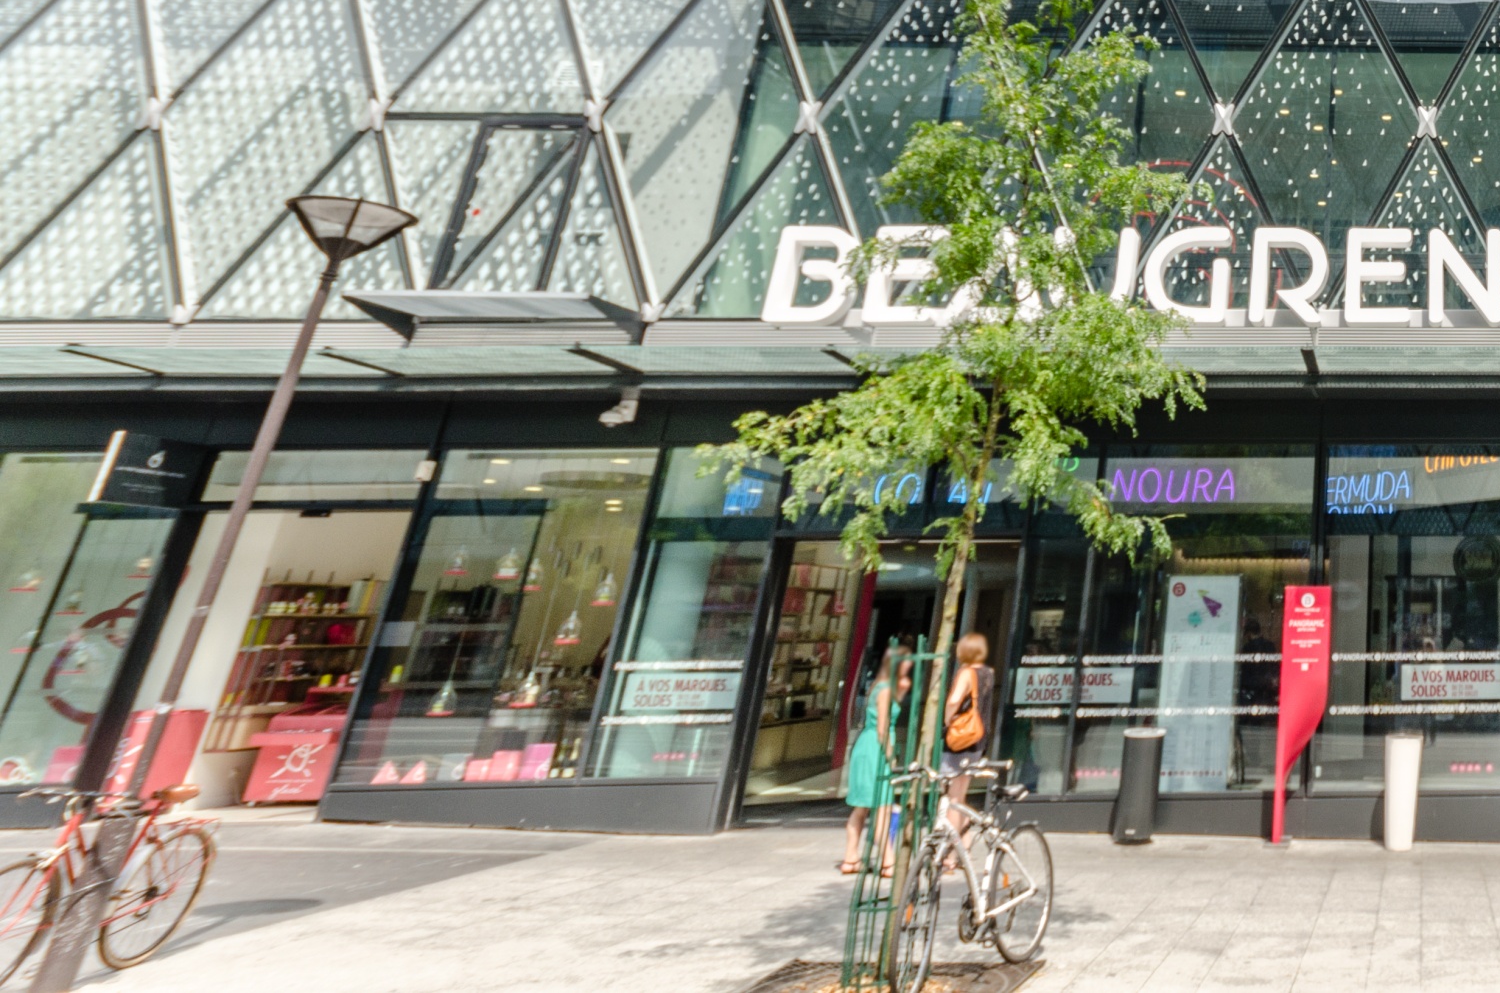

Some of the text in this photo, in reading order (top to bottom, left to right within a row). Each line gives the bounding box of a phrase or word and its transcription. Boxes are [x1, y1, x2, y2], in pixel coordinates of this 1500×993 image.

[1109, 467, 1236, 504] NOURA
[1327, 470, 1410, 505] ERMUDA
[1038, 673, 1059, 686] VOS
[1421, 670, 1443, 683] VOS
[648, 679, 671, 692] VOS
[1411, 684, 1447, 697] SOLDES
[633, 694, 672, 707] SOLDES
[1025, 688, 1062, 701] SOLDES
